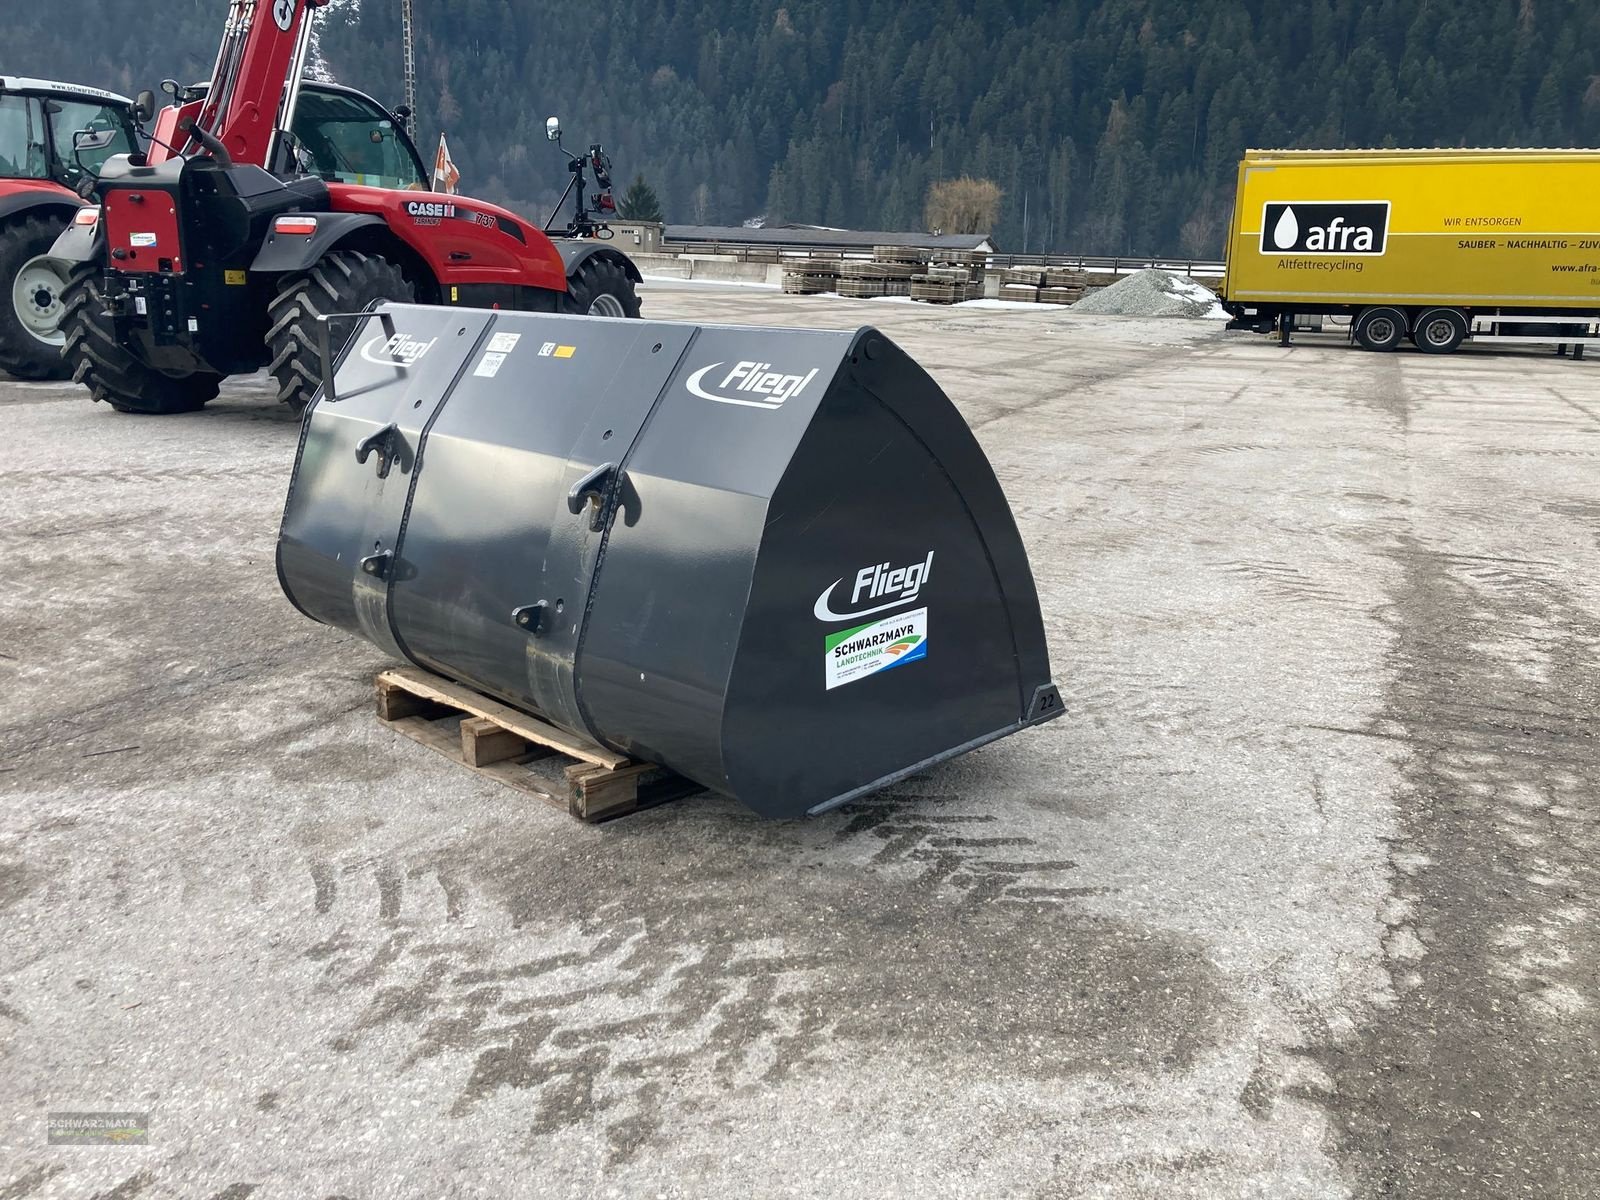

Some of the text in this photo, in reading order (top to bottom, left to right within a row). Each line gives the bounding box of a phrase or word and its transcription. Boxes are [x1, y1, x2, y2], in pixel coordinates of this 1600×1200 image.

[408, 201, 442, 217] CASE
[476, 212, 496, 228] 737
[1444, 217, 1522, 226] WIR ENTSORGEN
[1305, 217, 1373, 251] afra
[1458, 240, 1496, 249] SAUBER
[1507, 240, 1568, 249] NACHHALTIG
[1579, 240, 1600, 249] ZUV
[1277, 259, 1363, 273] Altfettrecycling
[379, 333, 438, 363] Fliegl
[718, 361, 820, 403] Fliegl
[851, 550, 935, 604] Fliegl
[835, 624, 914, 658] SCHWARZMAYR
[836, 647, 883, 668] LANDTECHNIK
[1041, 694, 1054, 711] 22
